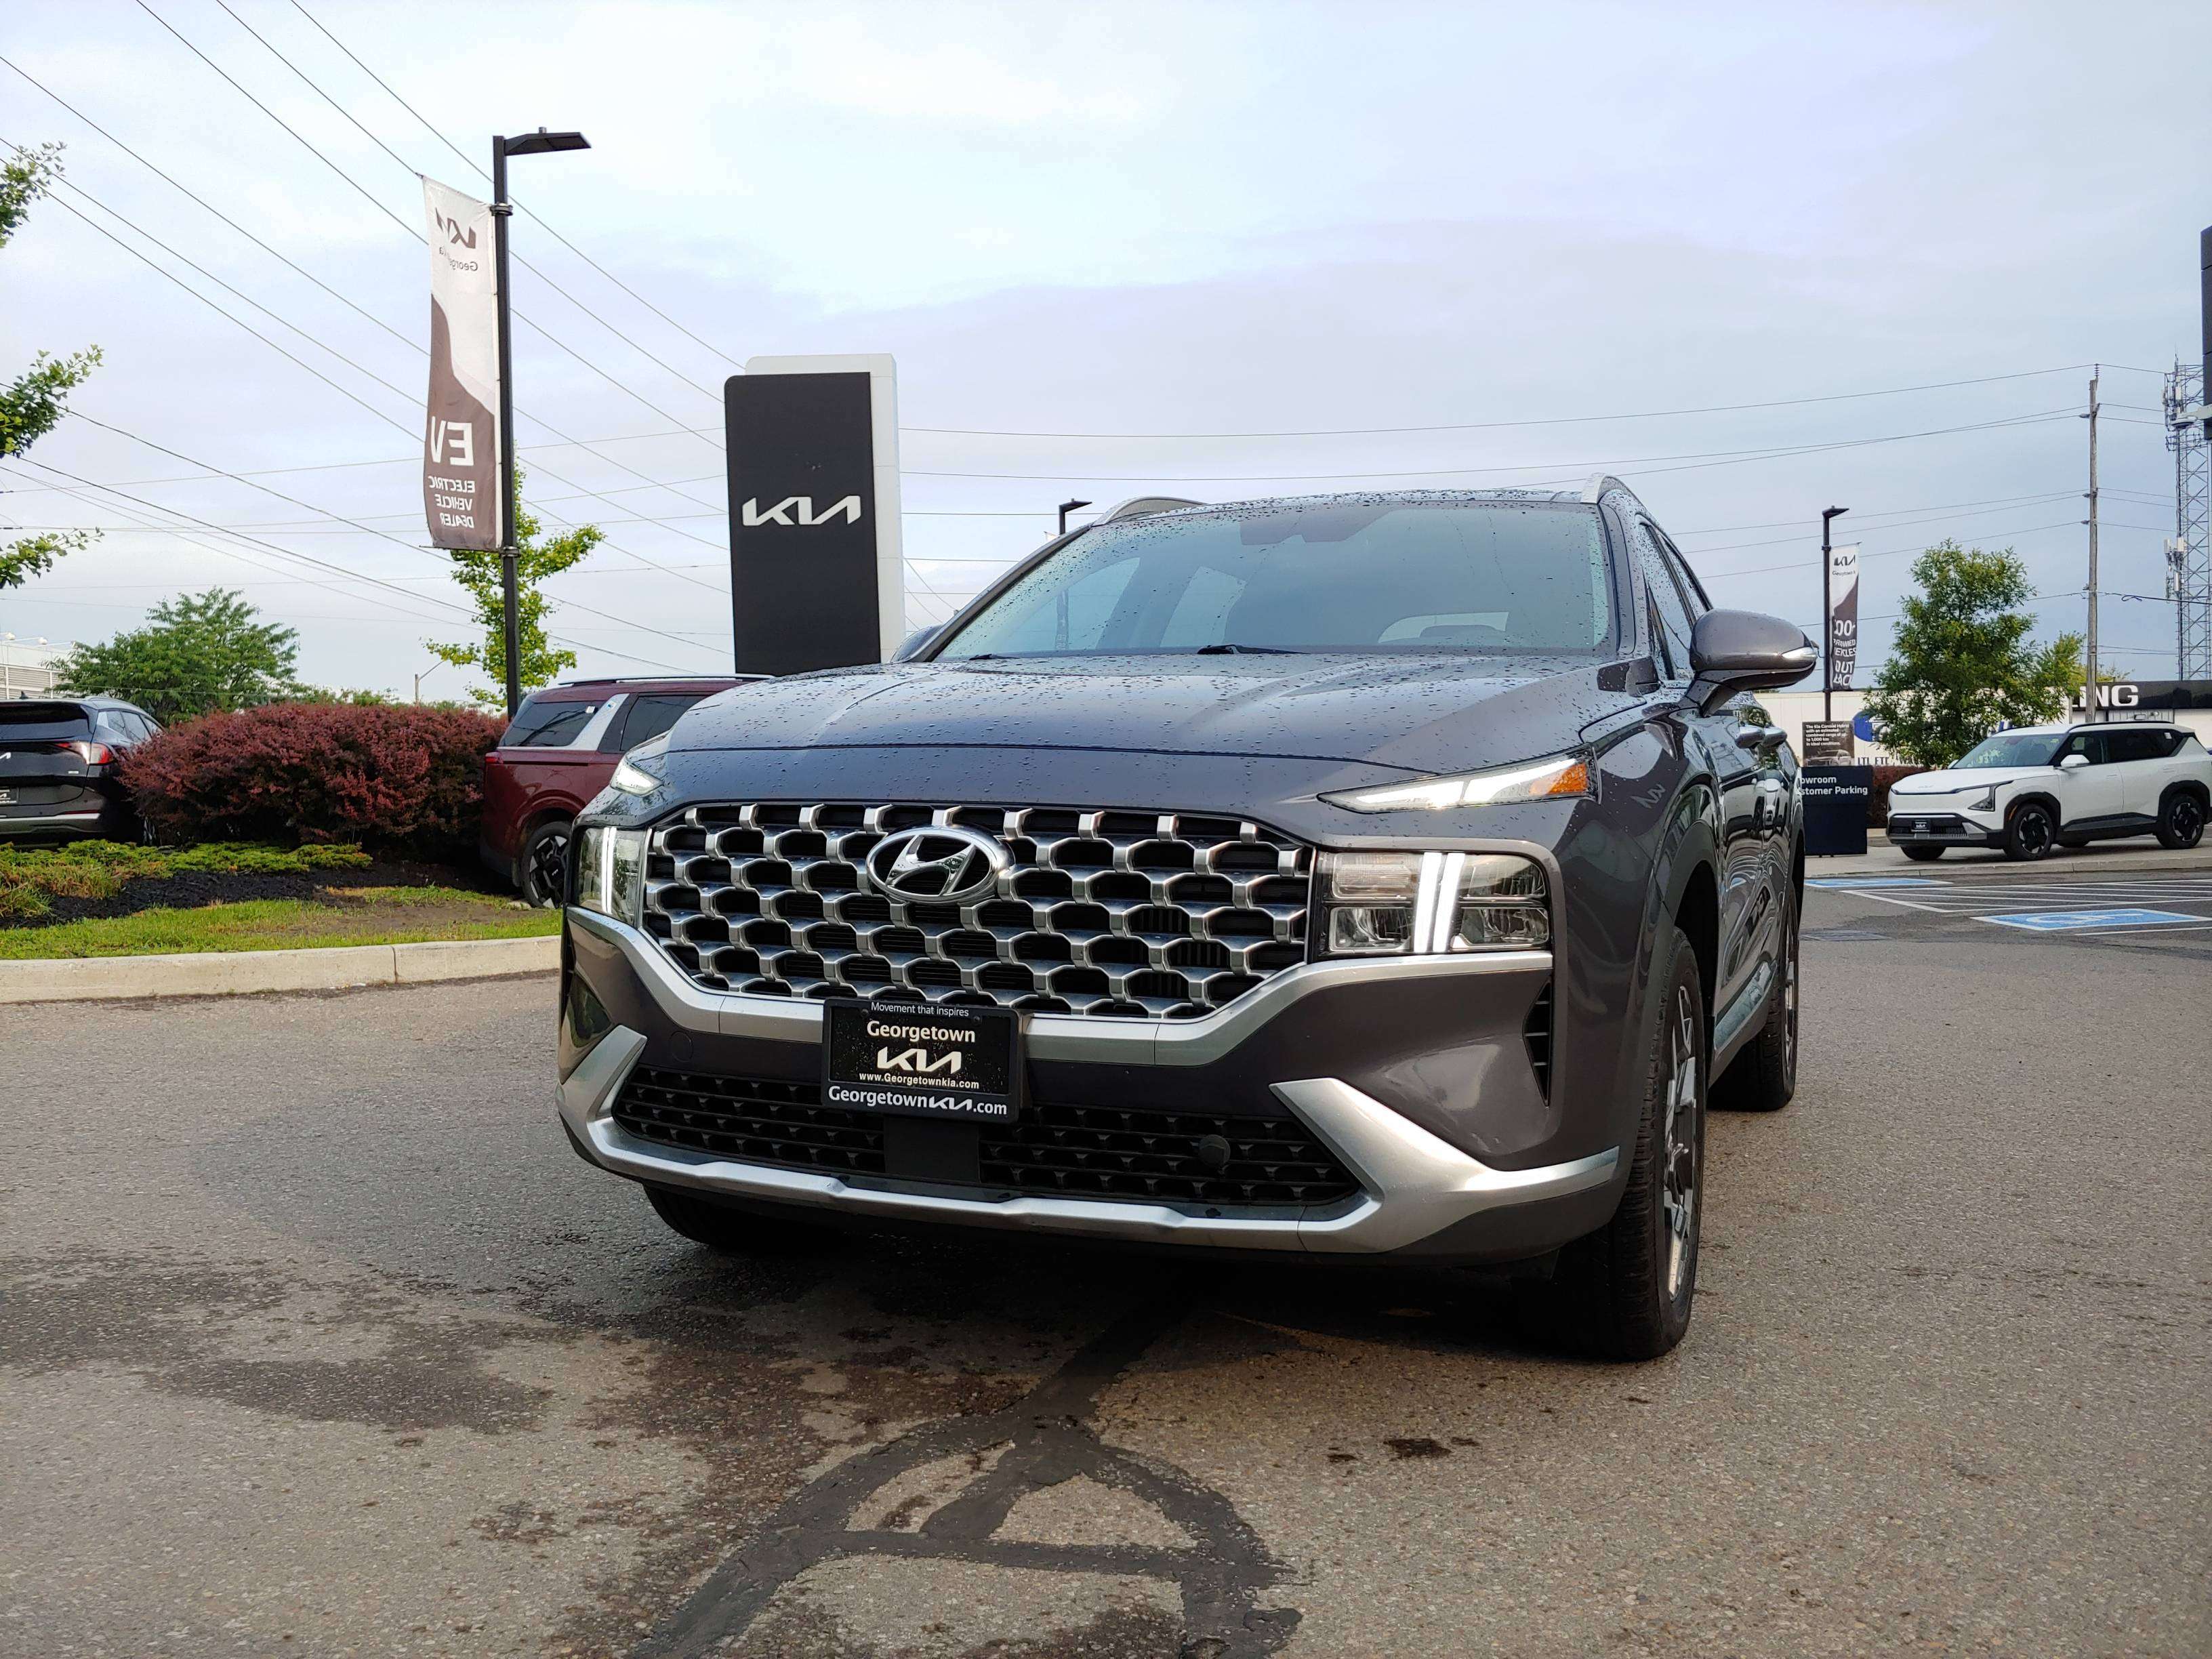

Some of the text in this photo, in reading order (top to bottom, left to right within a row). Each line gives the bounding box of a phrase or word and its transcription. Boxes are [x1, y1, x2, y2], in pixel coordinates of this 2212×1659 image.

[742, 495, 861, 527] KIA
[1834, 554, 1856, 566] KIA
[1835, 785, 1868, 796] Parking
[871, 1001, 969, 1017] Movement that inspires
[867, 1020, 976, 1043] Georgetown
[877, 1046, 962, 1075] KIA
[859, 1072, 979, 1089] www.Georgetownkia.com
